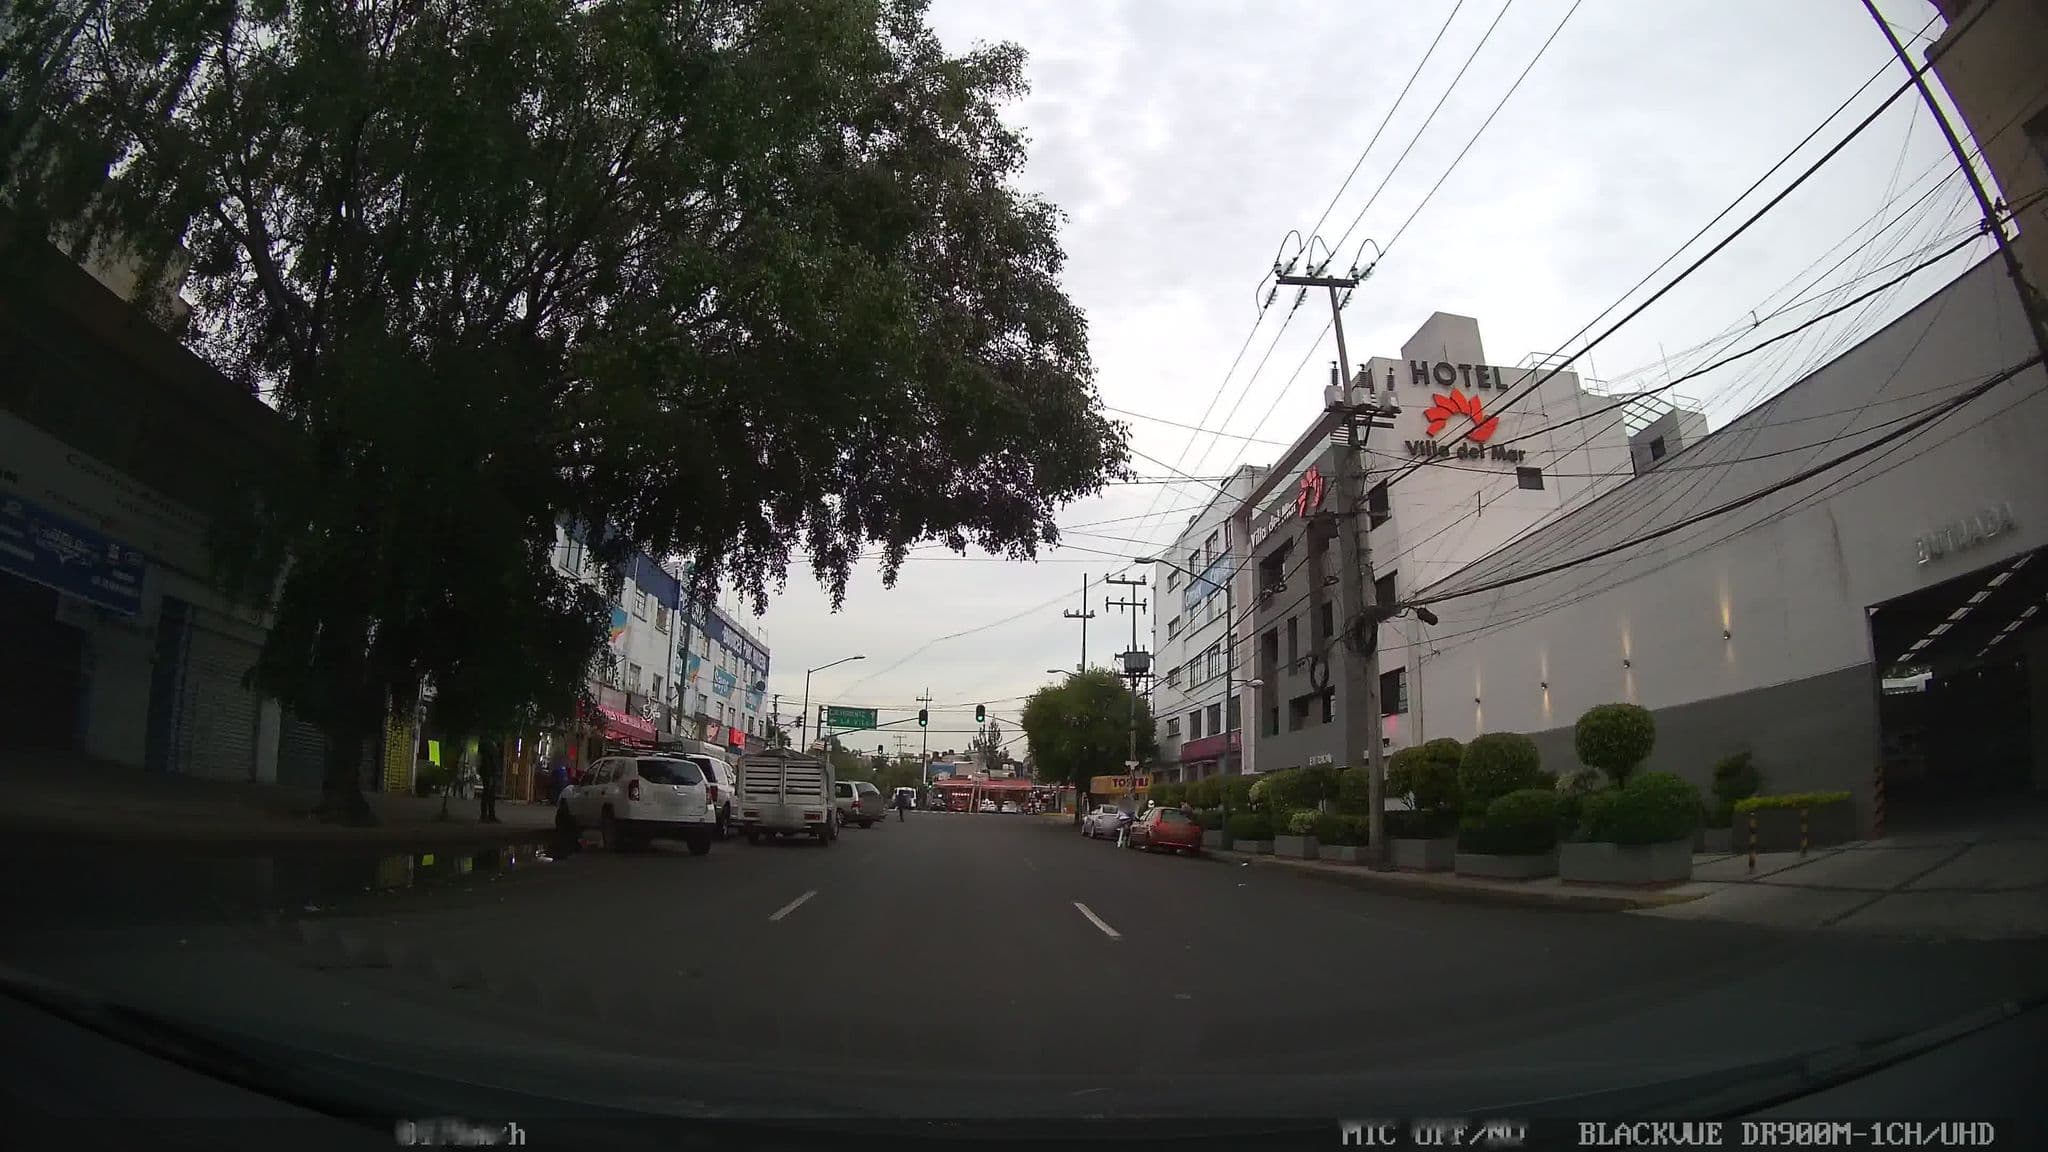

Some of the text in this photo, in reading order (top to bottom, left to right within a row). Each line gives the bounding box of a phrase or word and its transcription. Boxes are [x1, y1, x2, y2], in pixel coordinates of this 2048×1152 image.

[1410, 360, 1508, 390] HOTEL
[1405, 440, 1526, 463] Villa del Mar
[1250, 526, 1267, 549] Villa
